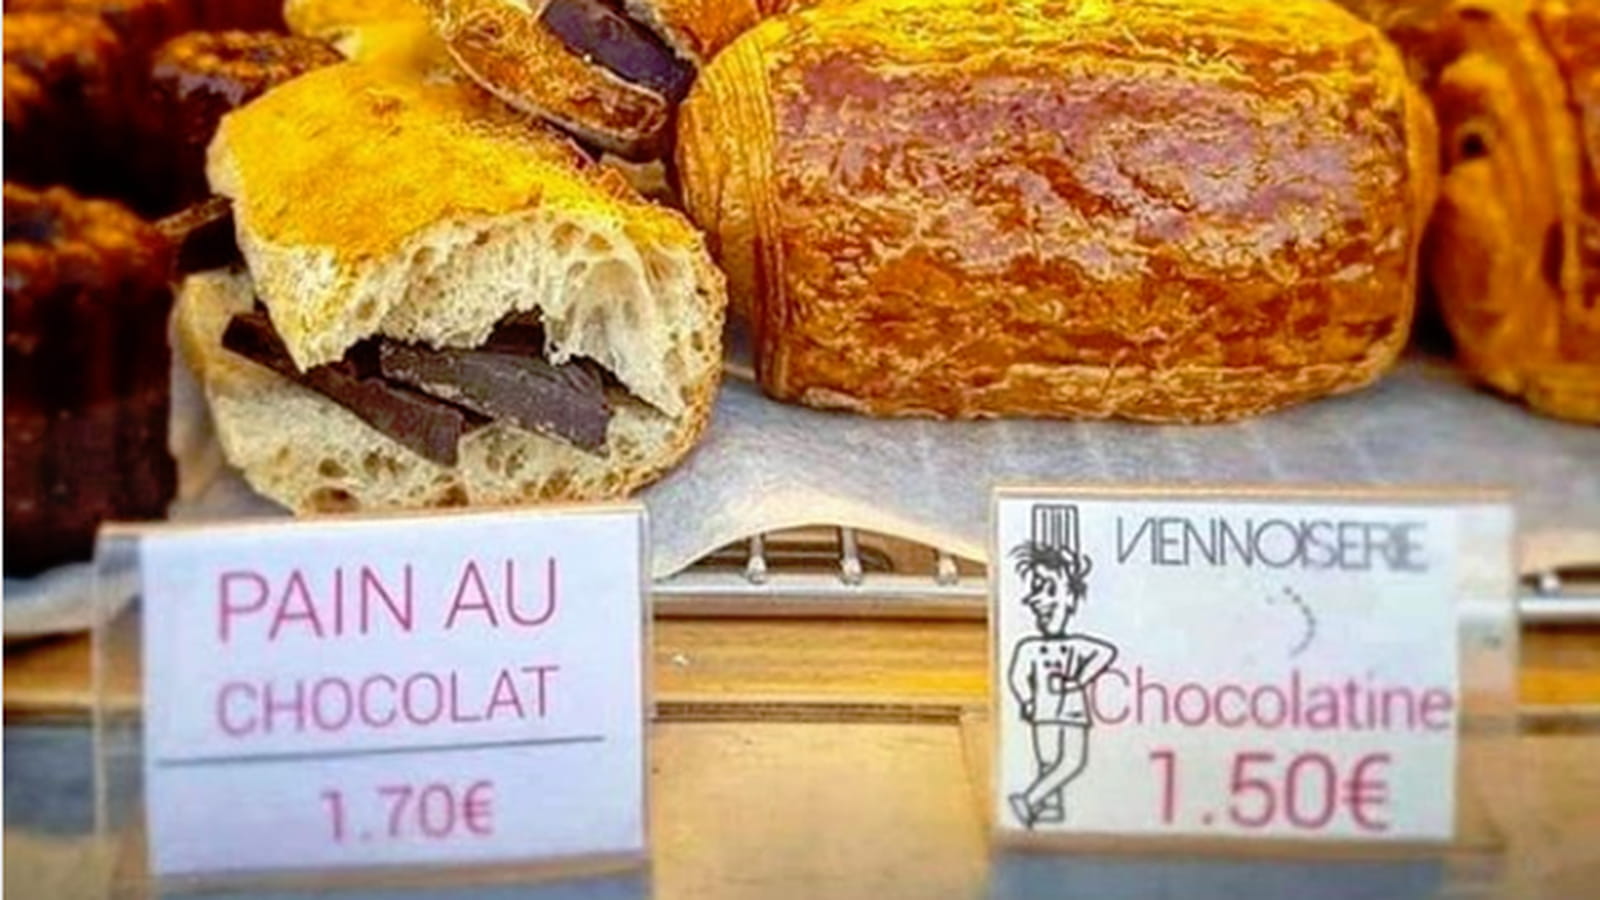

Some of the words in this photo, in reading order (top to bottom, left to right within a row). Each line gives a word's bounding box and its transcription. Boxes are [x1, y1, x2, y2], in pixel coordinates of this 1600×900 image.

[217, 564, 412, 643] PAIN
[446, 558, 557, 630] AU
[217, 666, 559, 736] CHOCOLAT
[1091, 667, 1453, 731] Chocolatine
[320, 781, 494, 843] 1.70€
[1149, 750, 1391, 830] 1.50€
